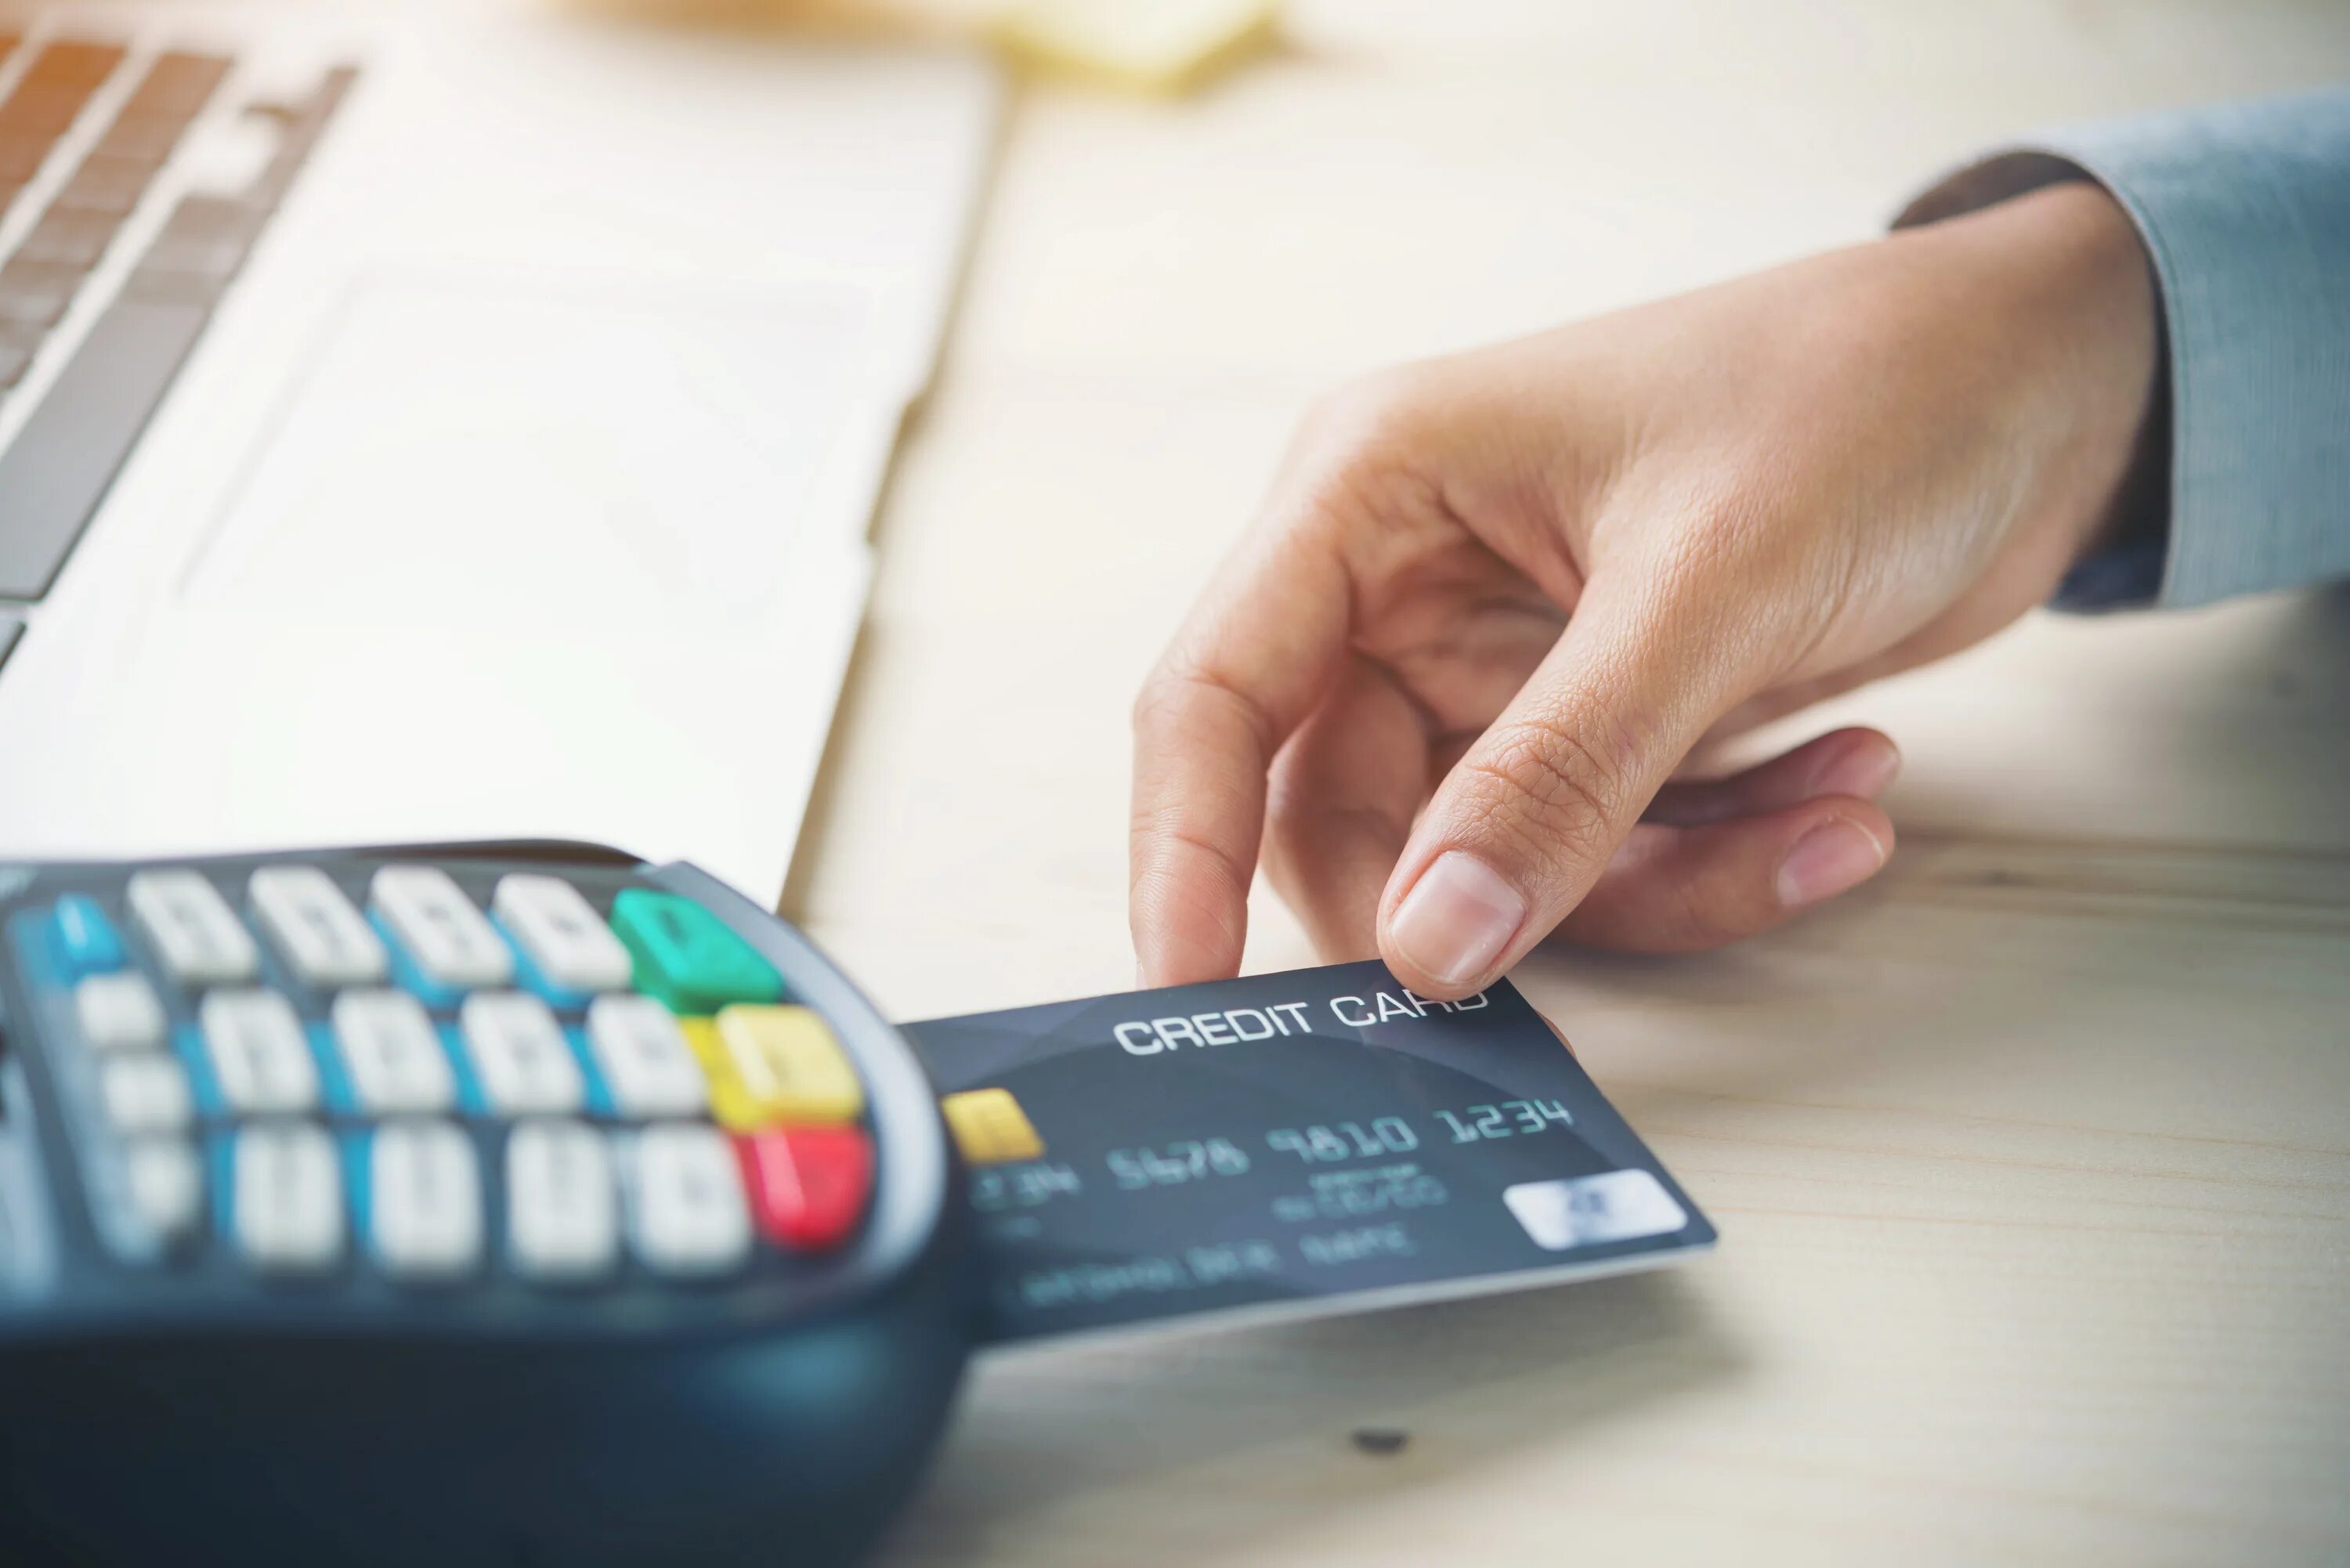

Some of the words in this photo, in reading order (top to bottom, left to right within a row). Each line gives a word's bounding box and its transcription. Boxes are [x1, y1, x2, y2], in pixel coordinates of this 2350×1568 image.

[1113, 1002, 1313, 1056] CREDIT
[1104, 1138, 1250, 1190] 5678
[1266, 1116, 1419, 1164] 9810
[1433, 1098, 1574, 1143] 1234
